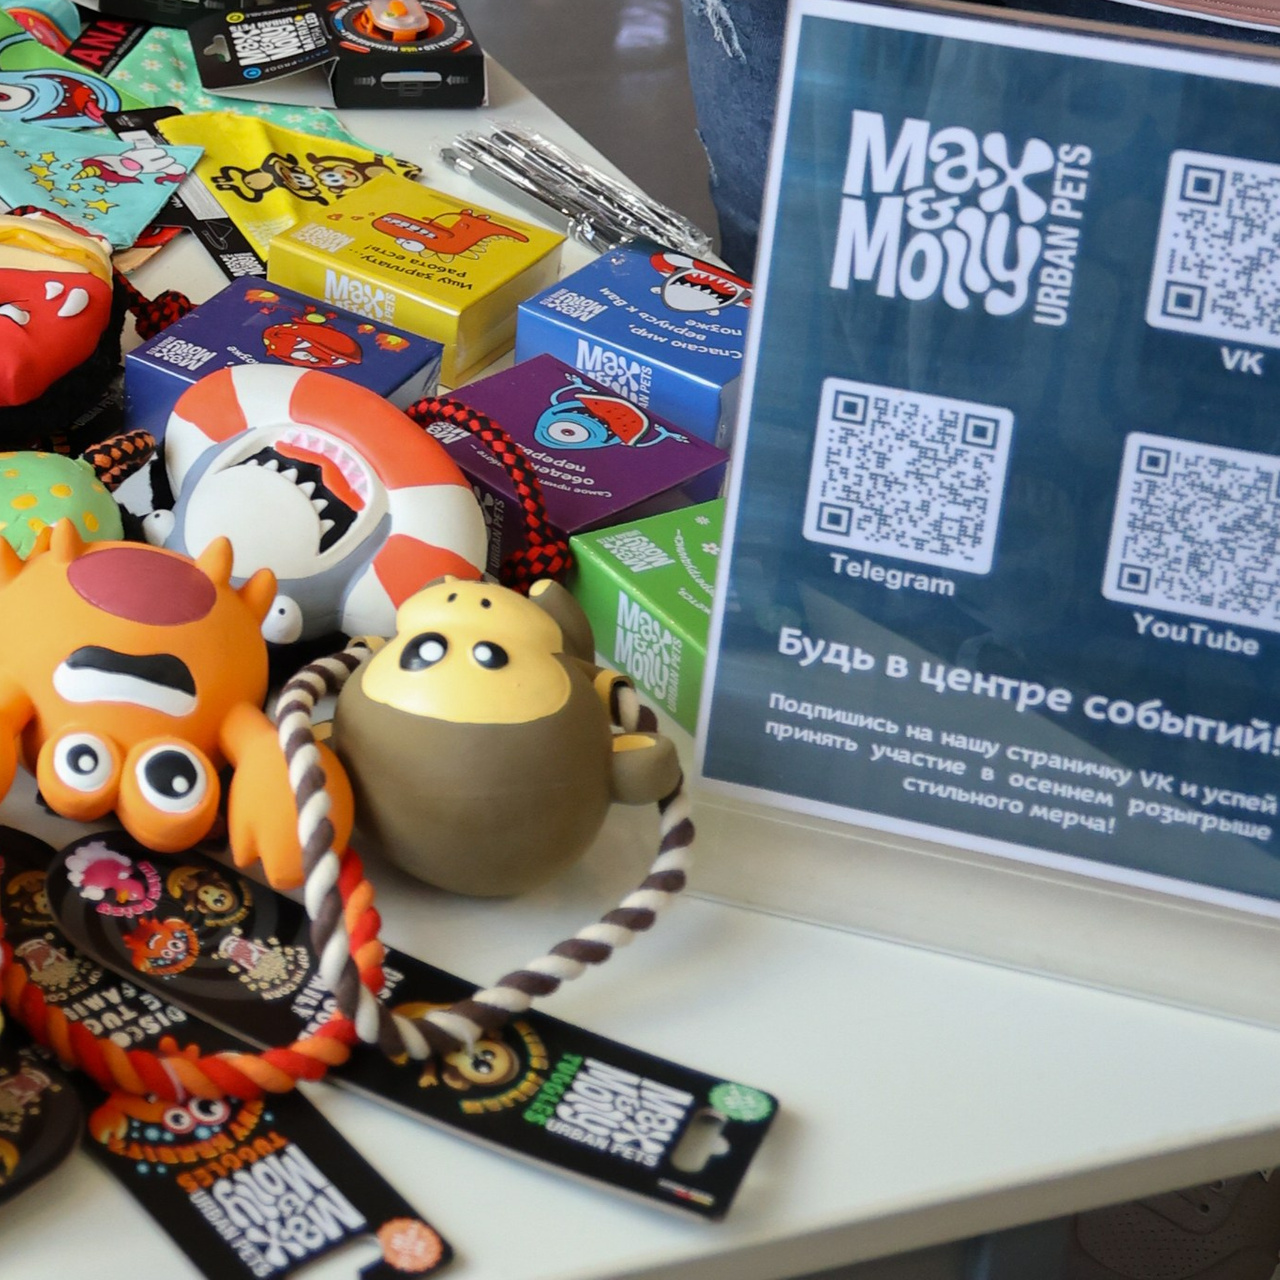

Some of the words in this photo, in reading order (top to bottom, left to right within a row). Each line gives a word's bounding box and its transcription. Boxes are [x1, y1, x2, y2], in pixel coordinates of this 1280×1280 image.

[228, 22, 257, 33] PETS
[258, 16, 294, 30] URBAN
[297, 19, 311, 53] MATRIX
[304, 12, 320, 28] LED
[70, 19, 131, 69] ANA
[232, 28, 269, 67] Max
[261, 24, 304, 62] Molly
[841, 108, 1056, 224] Max
[1049, 142, 1093, 220] PETS
[905, 188, 961, 231] &
[363, 243, 408, 261] есть!
[829, 195, 1043, 317] Molly
[325, 268, 384, 319] Max
[436, 276, 474, 292] Ищу
[1032, 223, 1081, 328] URBAN
[384, 292, 397, 321] PETS
[546, 299, 597, 323] Max
[559, 291, 609, 314] Molly
[598, 286, 627, 307] Вам
[626, 304, 639, 315] к
[627, 324, 669, 344] мир,
[638, 311, 707, 342] вернусь
[684, 318, 743, 336] позже
[159, 347, 203, 372] Max
[164, 339, 218, 363] Molly
[576, 338, 642, 391] Max
[670, 339, 743, 360] Спасаю
[1221, 346, 1264, 376] VK
[640, 365, 654, 395] PETS
[476, 450, 506, 469] аботе
[515, 444, 586, 473] переры
[529, 461, 595, 486] обеден
[572, 486, 614, 499] Самое
[493, 497, 507, 528] PETS
[490, 528, 504, 569] URBAN
[603, 539, 653, 574] Max
[626, 533, 676, 568] Molly
[829, 552, 955, 597] Telegram
[619, 589, 674, 665] Max
[1132, 612, 1260, 657] YouTube
[614, 626, 670, 700] Molly
[670, 636, 683, 671] PETS
[777, 625, 875, 674] Будь
[885, 653, 909, 679] в
[920, 660, 1073, 714] центре
[1082, 694, 1280, 758] событий!
[768, 692, 900, 735] Подпишись
[905, 723, 934, 743] на
[940, 731, 1001, 760] нашу
[1005, 743, 1133, 788] страничку
[1138, 768, 1175, 794] VK
[1179, 781, 1198, 799] и
[1202, 784, 1278, 816] успей
[764, 719, 859, 753] принять
[870, 742, 968, 776] участие
[980, 766, 995, 782] в
[1008, 771, 1115, 808] осеннем
[1127, 797, 1273, 841] розыгрыше
[902, 775, 1024, 815] стильного
[1029, 803, 1116, 836] мерча!
[521, 1053, 584, 1127] TUGGLES
[554, 1056, 641, 1137] Molly
[611, 1078, 694, 1154] Max
[544, 1118, 611, 1152] URBAN
[610, 1141, 660, 1168] PETS
[174, 1131, 288, 1193] TUGGLES
[211, 1141, 330, 1229] Molly
[187, 1188, 234, 1238] URBAN
[229, 1237, 272, 1279] PETS
[244, 1187, 367, 1268] Max
